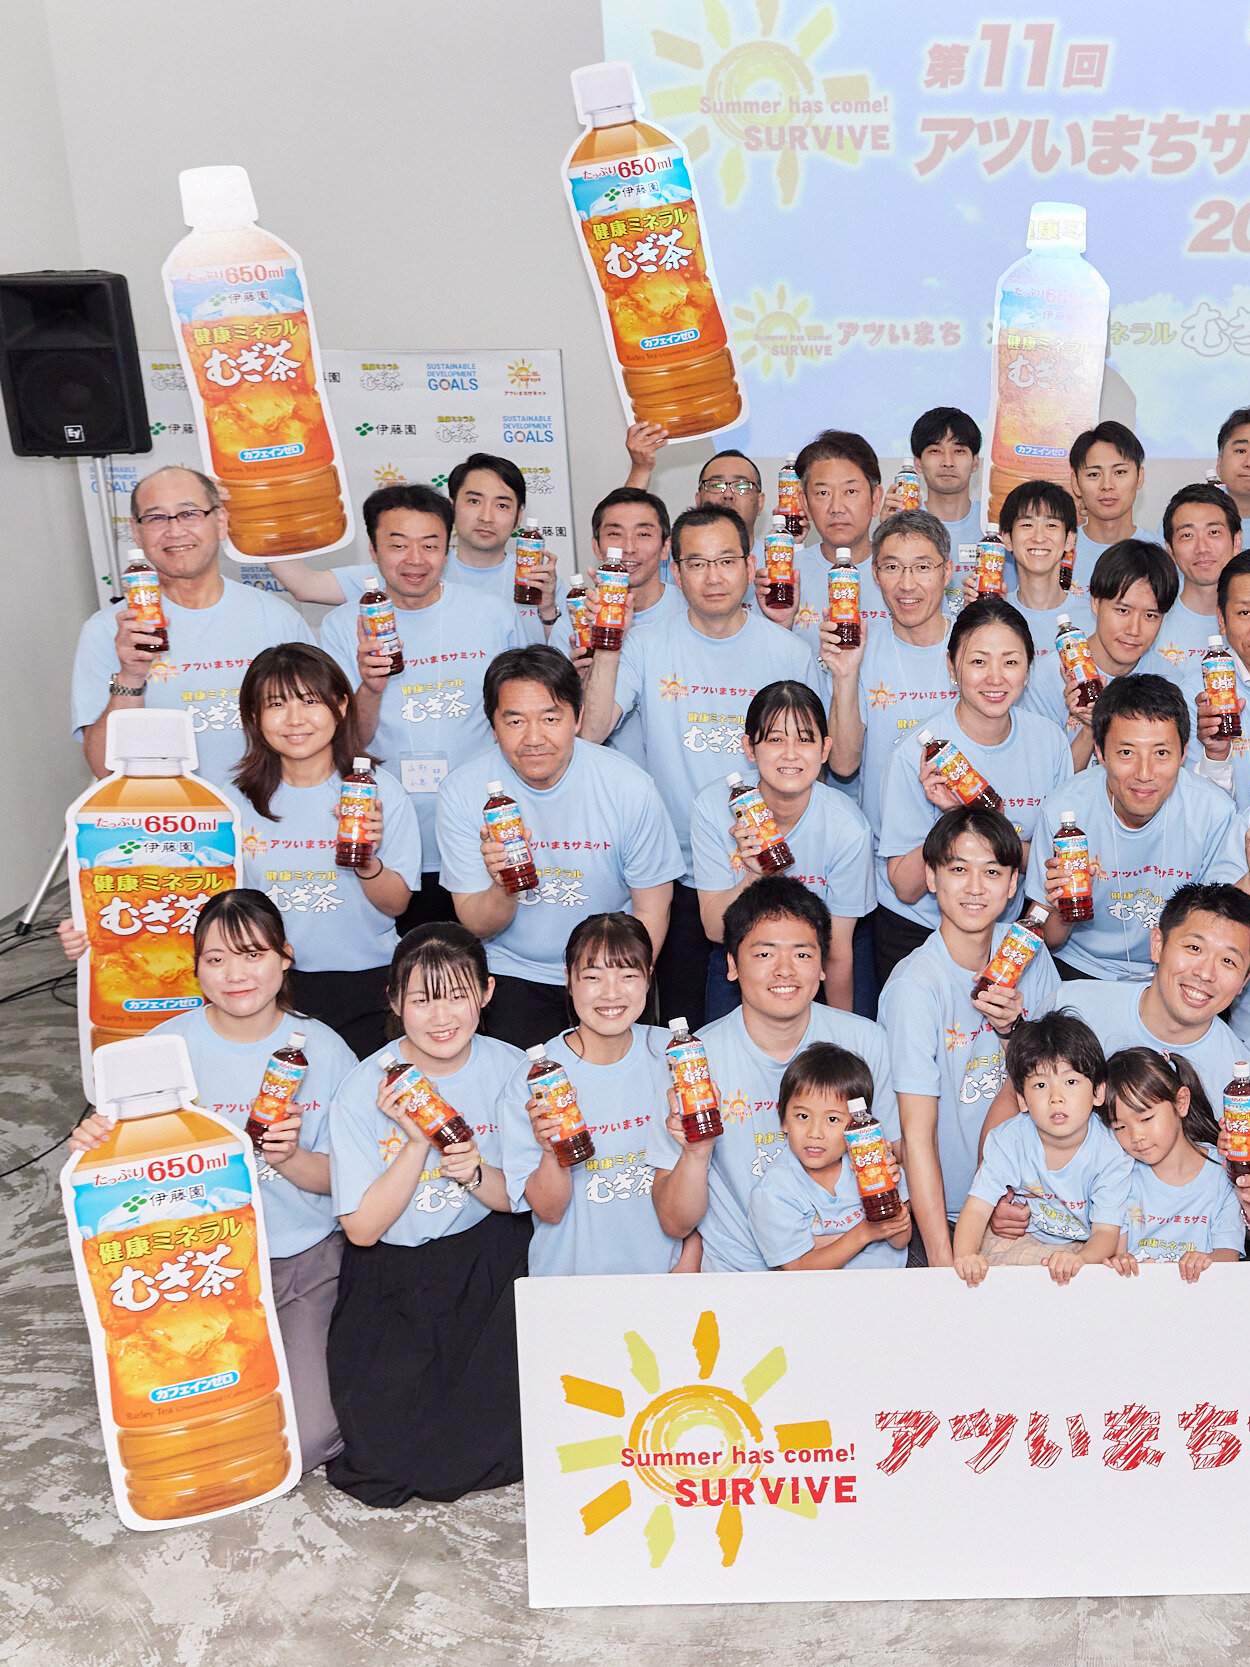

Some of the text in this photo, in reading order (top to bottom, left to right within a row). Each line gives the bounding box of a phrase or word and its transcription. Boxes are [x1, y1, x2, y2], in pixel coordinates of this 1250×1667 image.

[924, 23, 1109, 89] 第11回
[700, 95, 889, 114] Summer has come!
[743, 125, 890, 152] SURVIVE
[582, 155, 672, 181] たっぷり650ml
[622, 181, 660, 198] 伊藤園
[592, 205, 689, 242] 健康ミネラル
[602, 228, 694, 279] むぎ茶
[193, 319, 298, 346] 健康ミネラル
[642, 329, 696, 349] カフェインゼロ
[837, 321, 961, 346] アツいまち
[203, 339, 302, 387] むぎ茶
[428, 378, 478, 391] GOALS
[376, 423, 417, 436] 伊藤園
[504, 431, 554, 443] GOALS
[400, 689, 472, 723] むぎ茶
[682, 725, 745, 754] むぎ茶
[95, 815, 217, 833] たっぷり650ml
[143, 841, 194, 853] 伊藤園
[93, 873, 223, 892] 健康ミネラル
[266, 883, 344, 914] むぎ茶
[129, 999, 198, 1009] カフェインゼロ
[92, 1150, 229, 1188] たっぷり650ml
[854, 1151, 884, 1169] むぎ茶
[147, 1183, 205, 1208] 伊藤園
[583, 1164, 654, 1204] むぎ茶
[97, 1215, 244, 1265] 健康ミネラル
[107, 1245, 244, 1314] むぎ茶
[156, 1373, 234, 1401] カフェインゼロ
[621, 1443, 856, 1467] Summer has come!
[675, 1476, 857, 1507] SURVIVE
